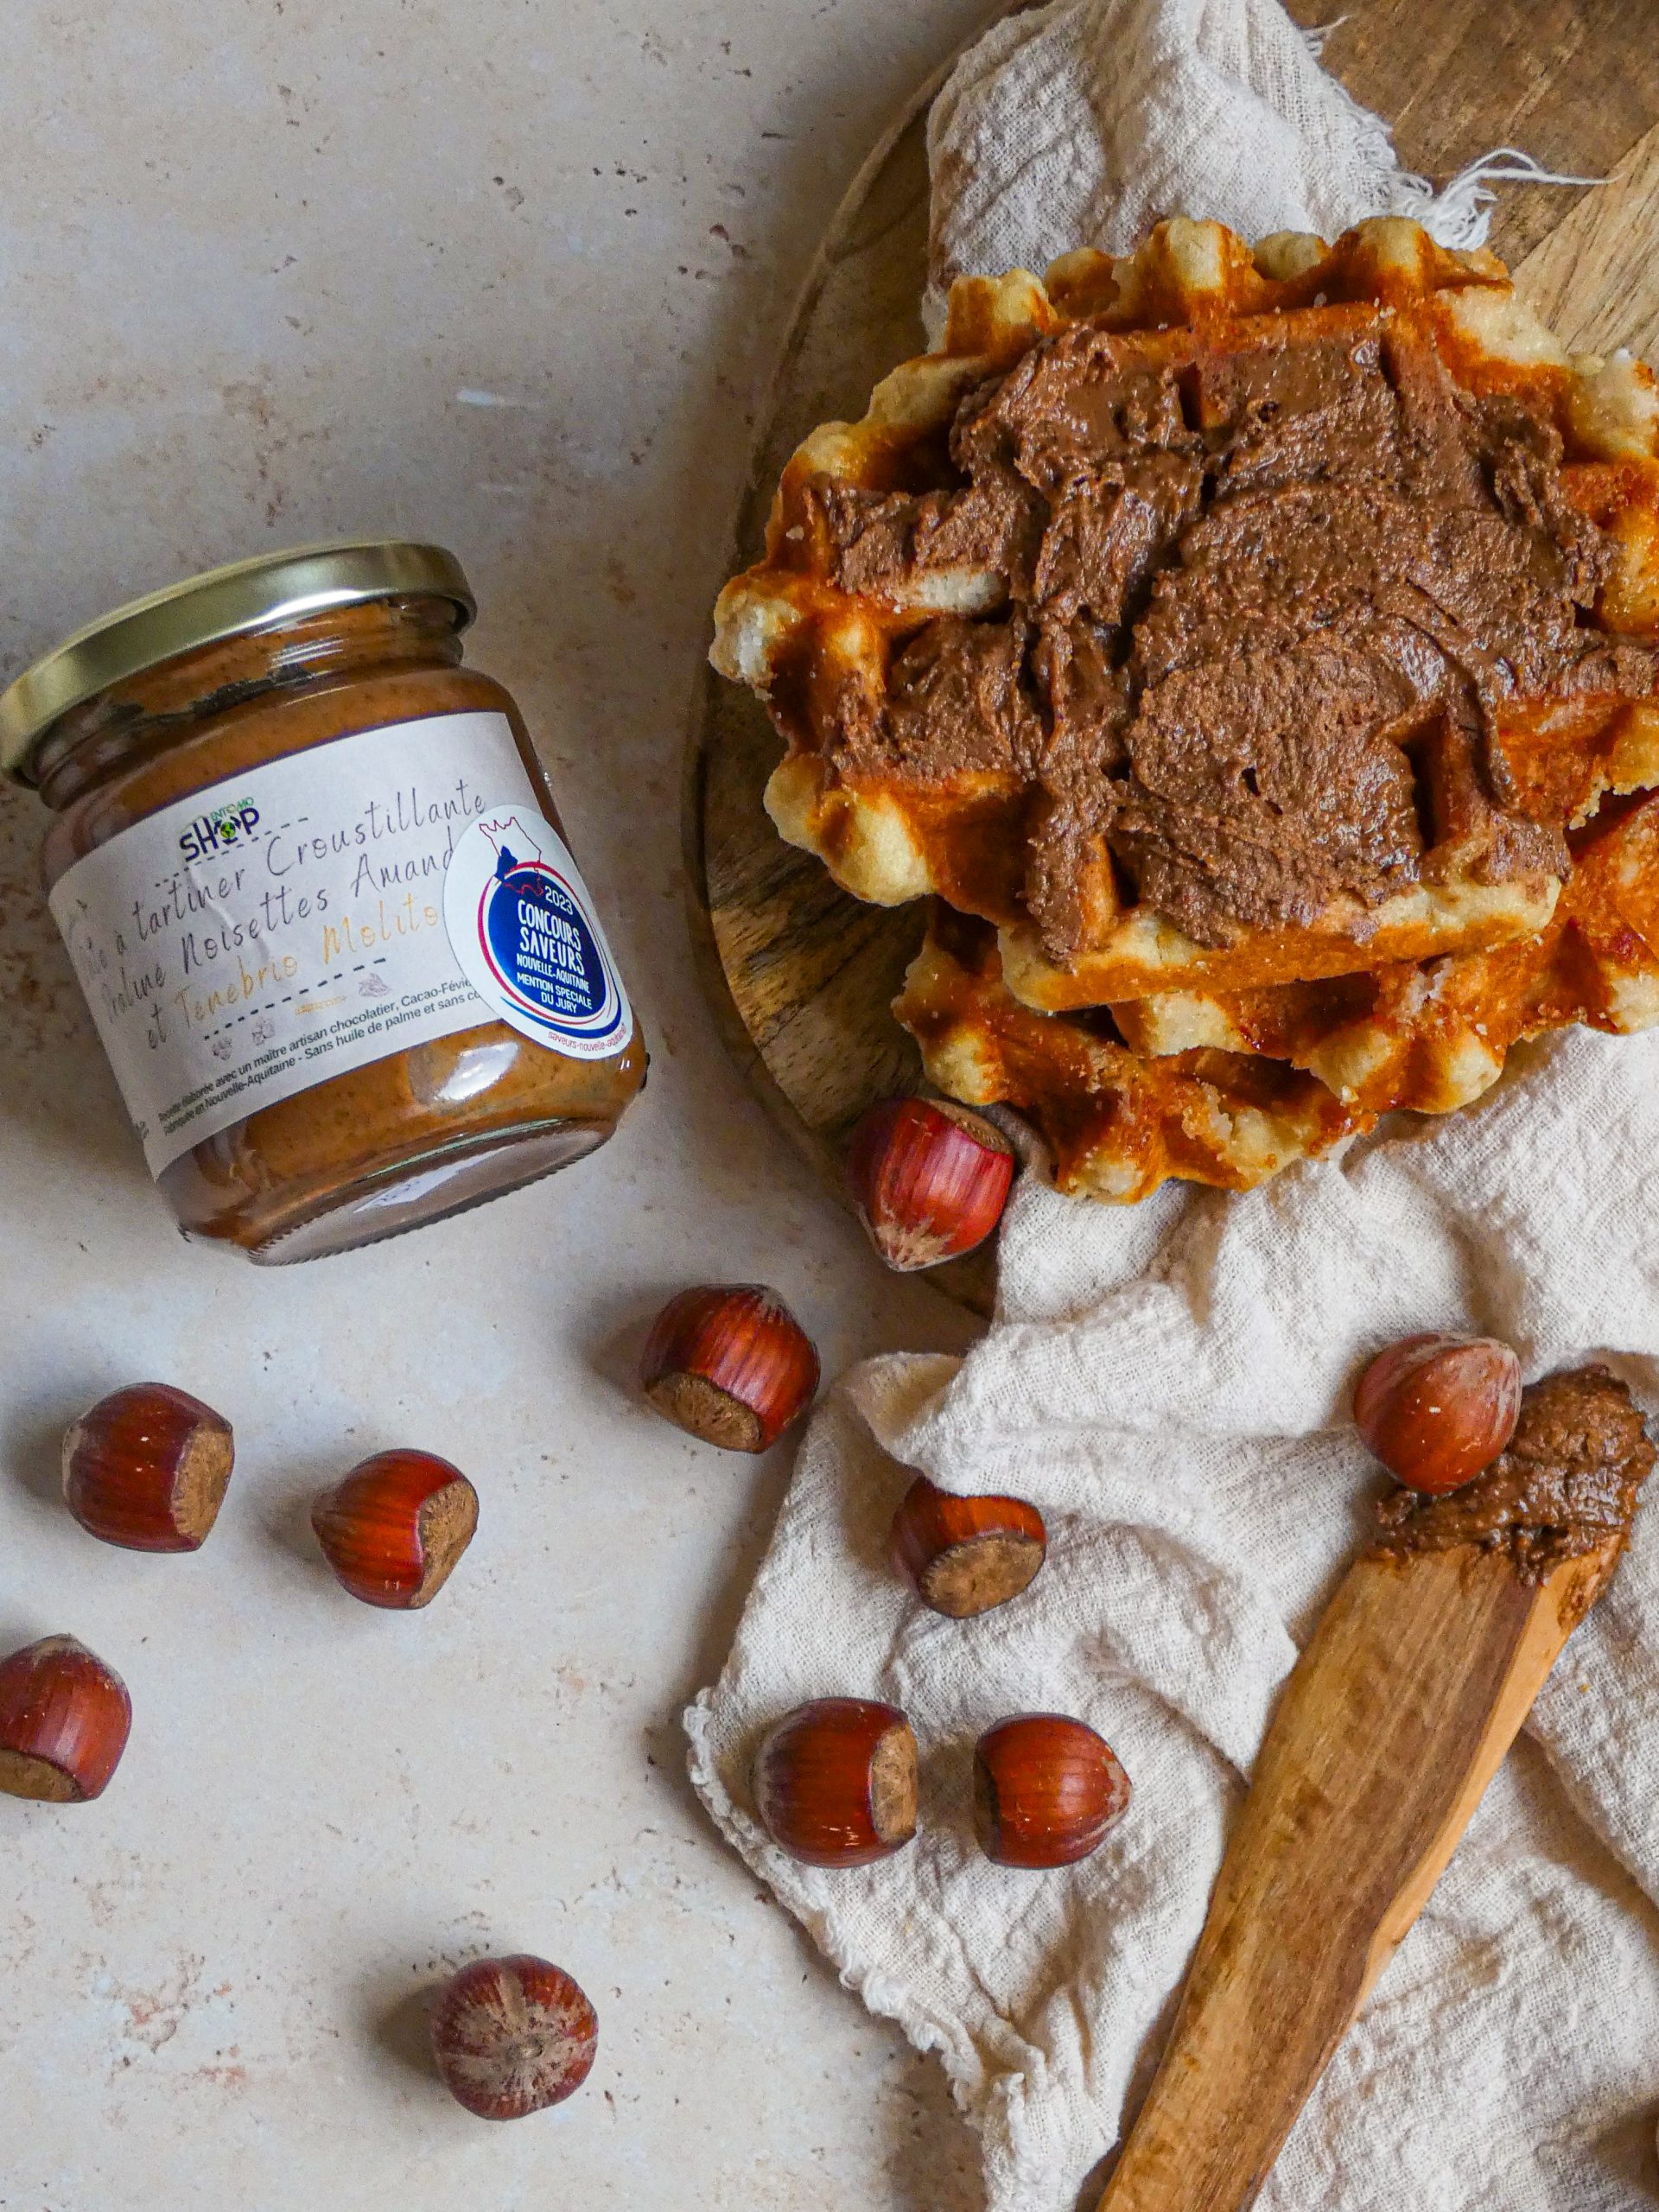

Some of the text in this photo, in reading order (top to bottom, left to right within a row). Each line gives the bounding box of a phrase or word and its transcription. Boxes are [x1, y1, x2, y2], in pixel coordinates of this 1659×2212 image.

[132, 868, 248, 944] tartiner
[267, 779, 486, 876] Croustillante
[179, 807, 260, 862] SHOP
[517, 899, 582, 953] CONCOURS
[543, 885, 574, 916] 2023
[182, 885, 329, 974] Noisettes
[519, 926, 585, 976] SAVEURS
[148, 894, 439, 1049] et Tenebrio Molito
[516, 953, 591, 995] NOUVELLE-AQUITAINE
[517, 972, 593, 1010] MENTION SPECIALE
[541, 991, 578, 1014] DU JURY
[204, 1056, 296, 1106] Nouvelle-Aquitaine
[305, 1040, 334, 1061] Sans
[335, 1025, 365, 1047] huile
[366, 1020, 383, 1035] de
[385, 1008, 422, 1030] palme
[423, 1001, 436, 1015] et
[437, 995, 466, 1012] sans
[215, 1070, 238, 1088] avec
[238, 1063, 252, 1076] un
[253, 1046, 287, 1069] maître
[289, 1028, 328, 1053] artisan
[330, 1001, 400, 1034] chocolatier,
